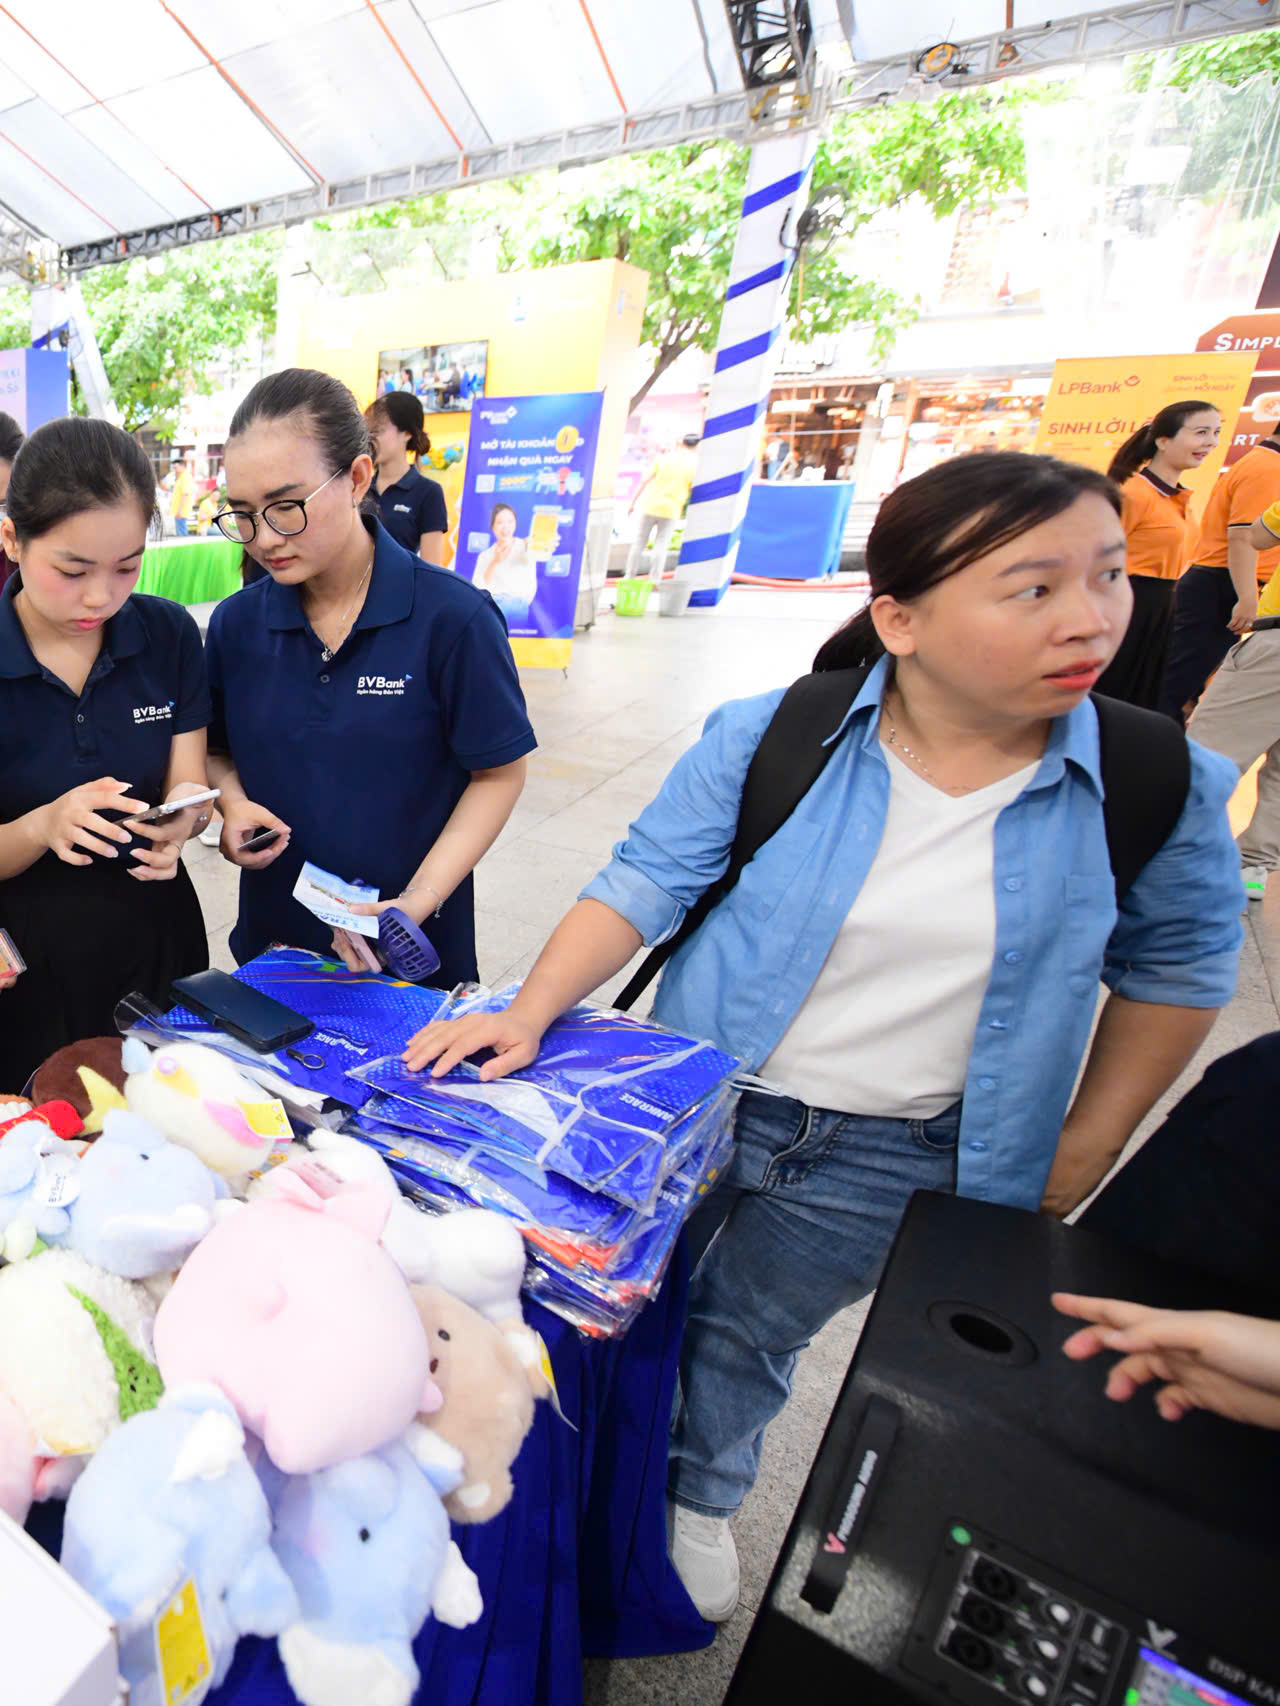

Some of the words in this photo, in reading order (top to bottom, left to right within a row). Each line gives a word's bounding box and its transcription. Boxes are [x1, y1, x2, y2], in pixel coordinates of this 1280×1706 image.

[1058, 381, 1123, 395] LPBank
[1048, 421, 1093, 434] SINH
[1232, 433, 1260, 446] RT
[357, 676, 406, 688] BVBank
[133, 705, 171, 719] BVBank
